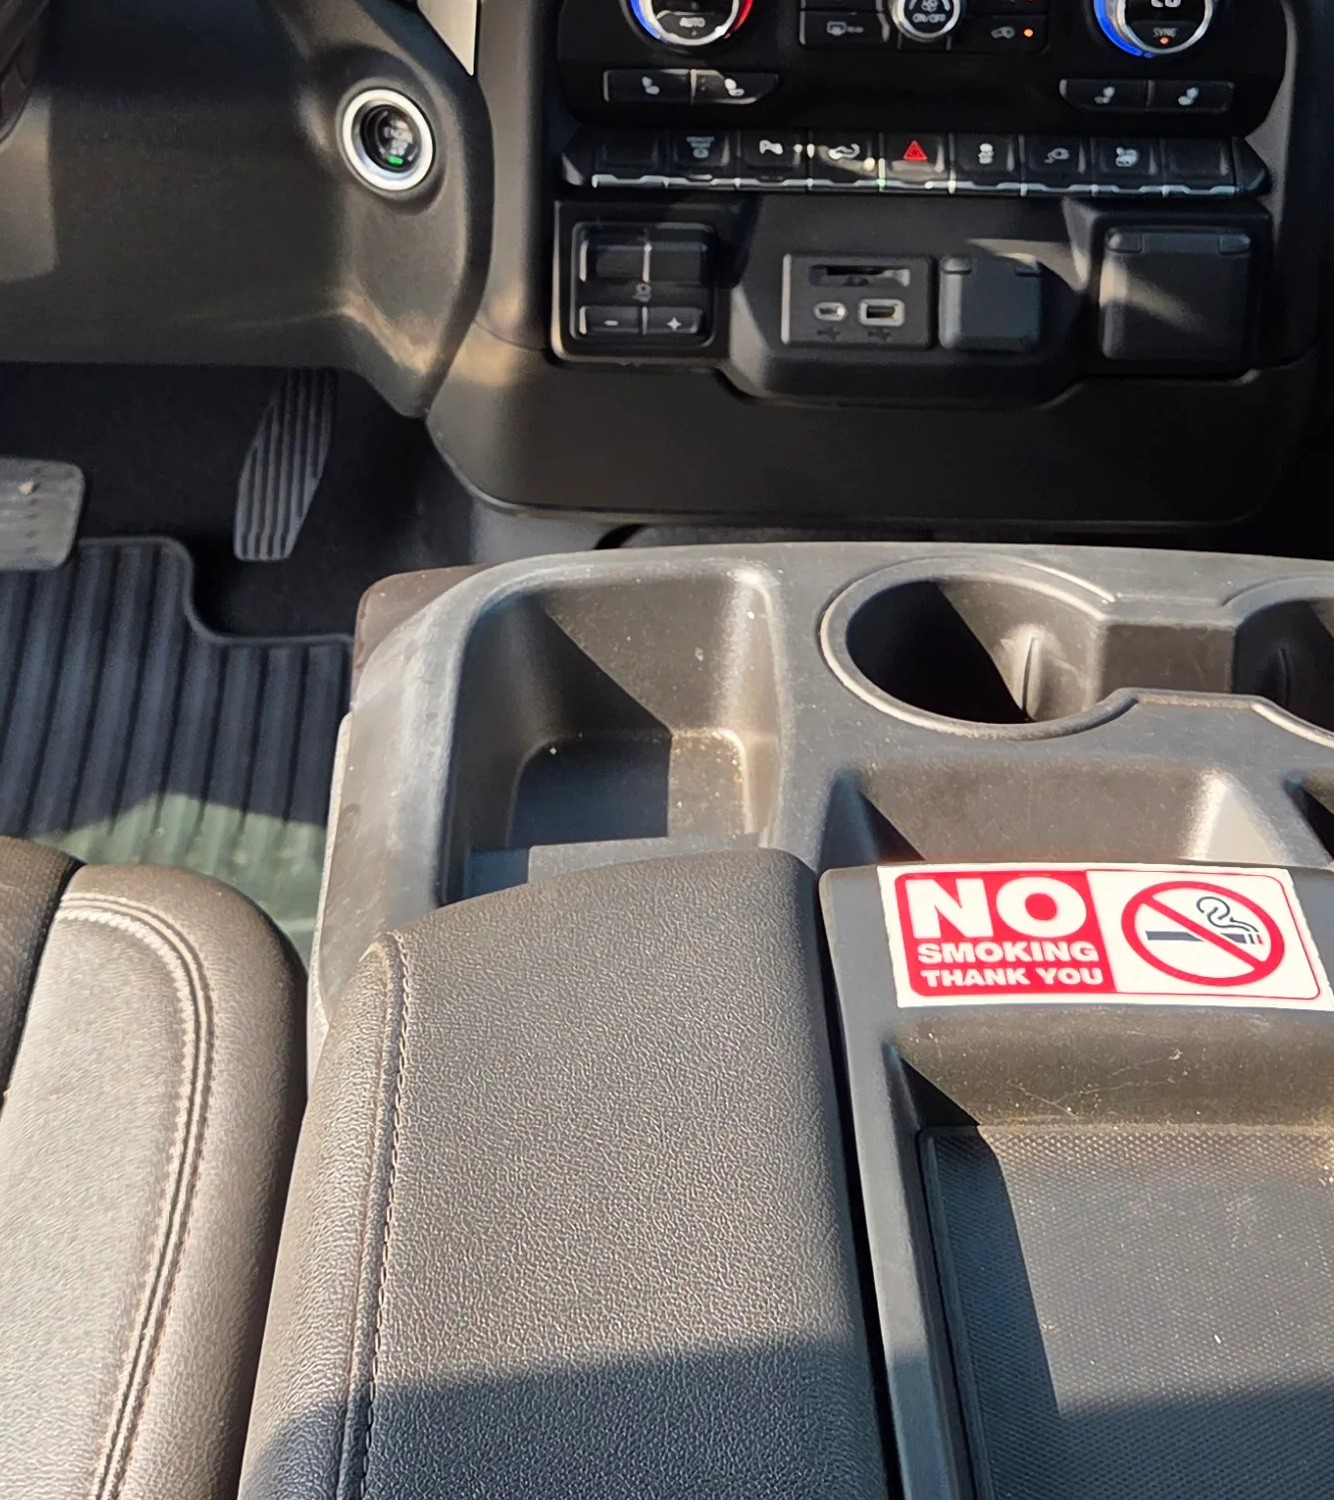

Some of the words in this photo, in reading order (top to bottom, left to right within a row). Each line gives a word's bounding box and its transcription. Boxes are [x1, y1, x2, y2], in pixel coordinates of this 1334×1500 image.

[912, 13, 946, 23] ON/OFF
[904, 877, 1087, 939] NO
[917, 941, 1099, 964] SMOKING
[921, 967, 1030, 987] THANK
[1037, 967, 1104, 986] YOU
